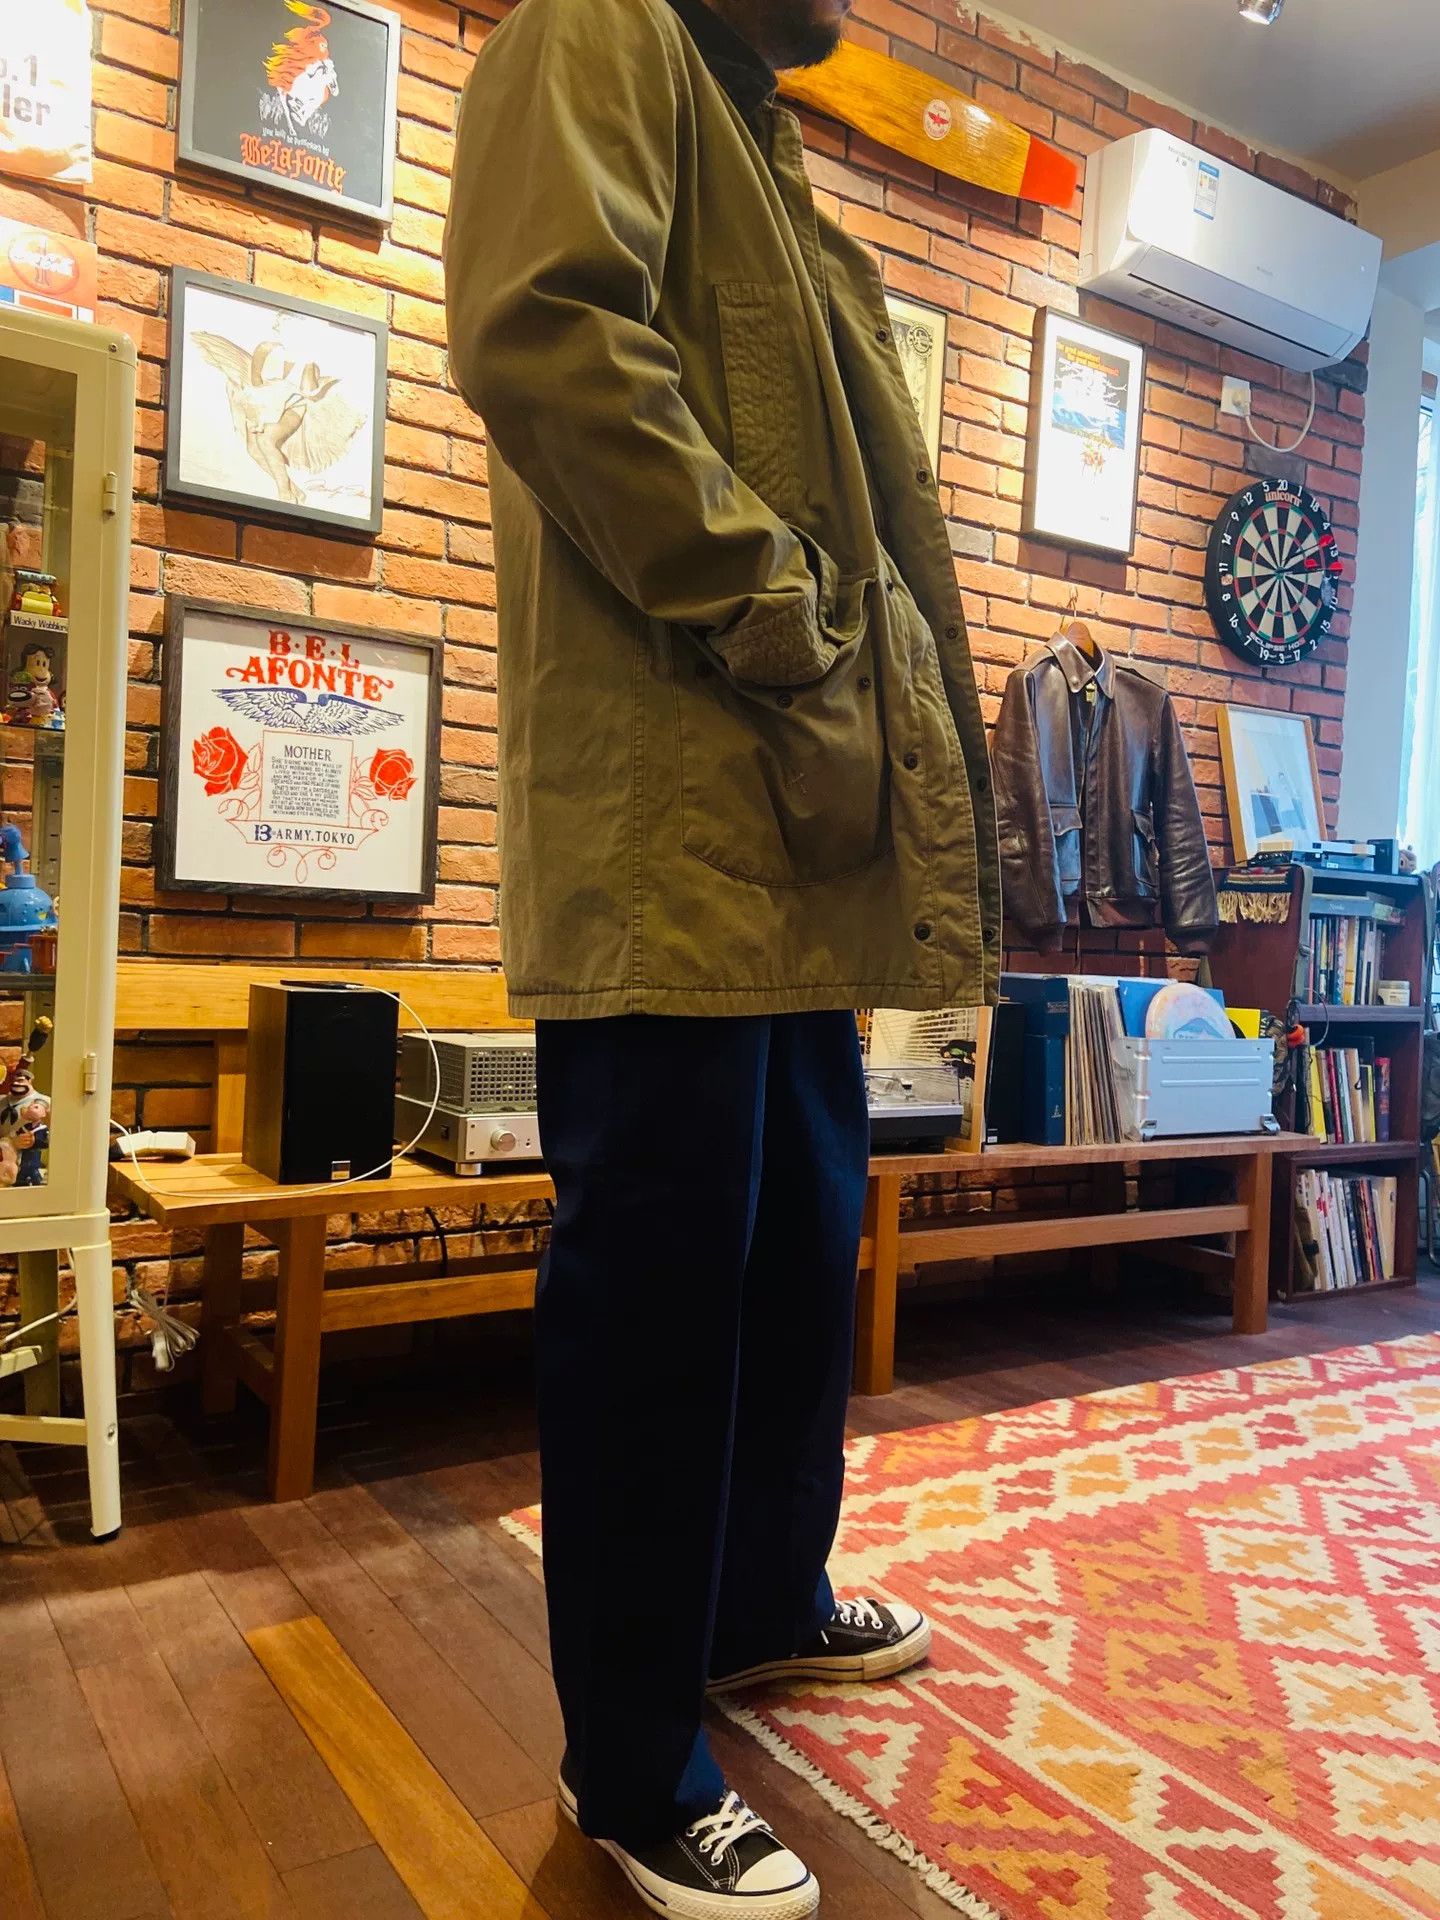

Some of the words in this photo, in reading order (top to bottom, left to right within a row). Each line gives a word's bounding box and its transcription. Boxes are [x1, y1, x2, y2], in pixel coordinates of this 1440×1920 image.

[1262, 481, 1270, 492] 5
[1278, 479, 1288, 491] 20
[1297, 485, 1303, 497] 1
[1243, 491, 1254, 505] 12
[1310, 497, 1320, 512] 18
[1230, 511, 1239, 522] 9
[1322, 522, 1331, 530] 4
[1221, 532, 1232, 546] 14
[1329, 543, 1339, 557] 13
[1218, 562, 1228, 573] 11
[1222, 592, 1231, 602] 8
[13, 615, 37, 629] Wacky
[1228, 613, 1239, 628] 16
[1320, 620, 1331, 633] 15
[1243, 635, 1252, 646] 7
[1309, 639, 1318, 651] 2
[1259, 646, 1269, 660] 19
[1278, 652, 1285, 664] 3
[225, 655, 395, 703] AFONTE
[284, 745, 332, 761] MOTHER
